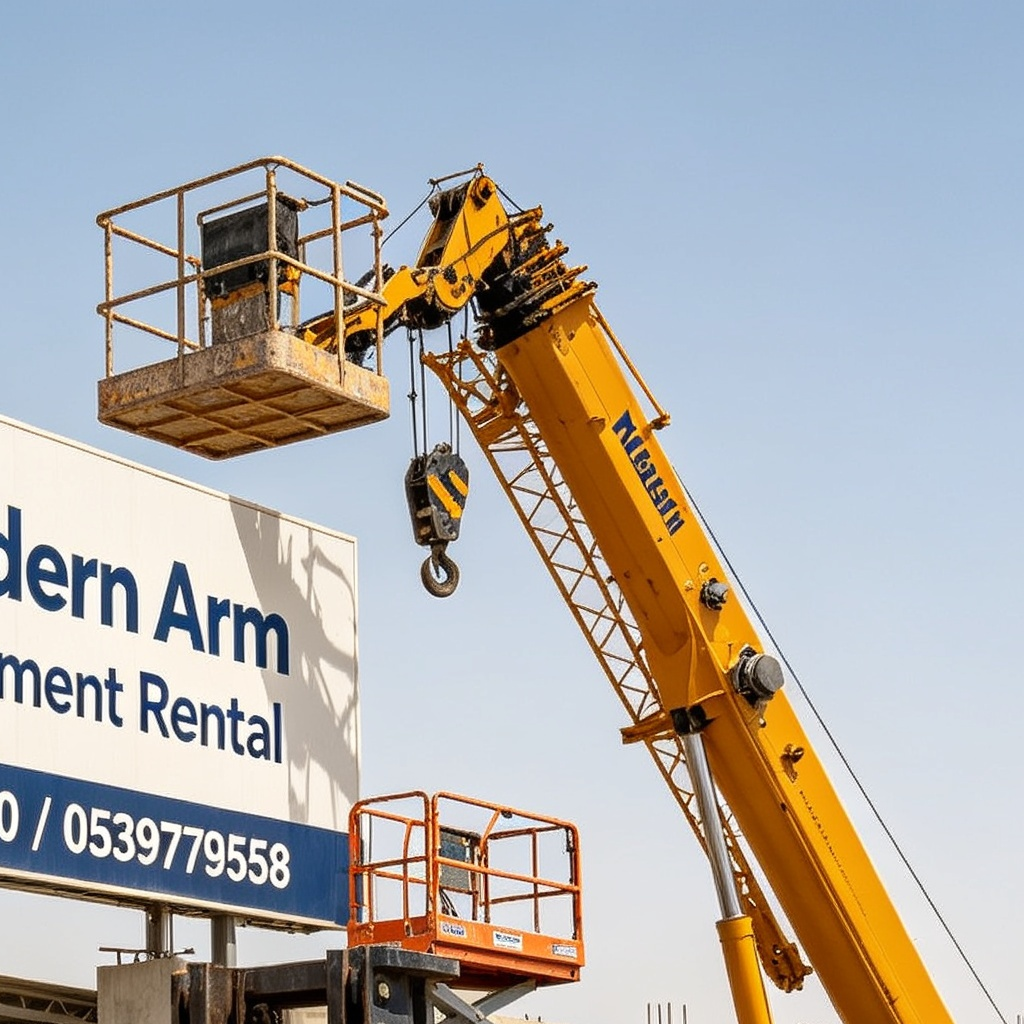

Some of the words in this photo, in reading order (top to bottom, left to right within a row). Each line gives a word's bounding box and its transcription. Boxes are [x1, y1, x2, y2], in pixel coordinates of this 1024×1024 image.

[153, 561, 291, 676] Arm
[139, 671, 282, 764] Rental
[31, 796, 52, 852] /
[62, 803, 292, 889] 0539779558
